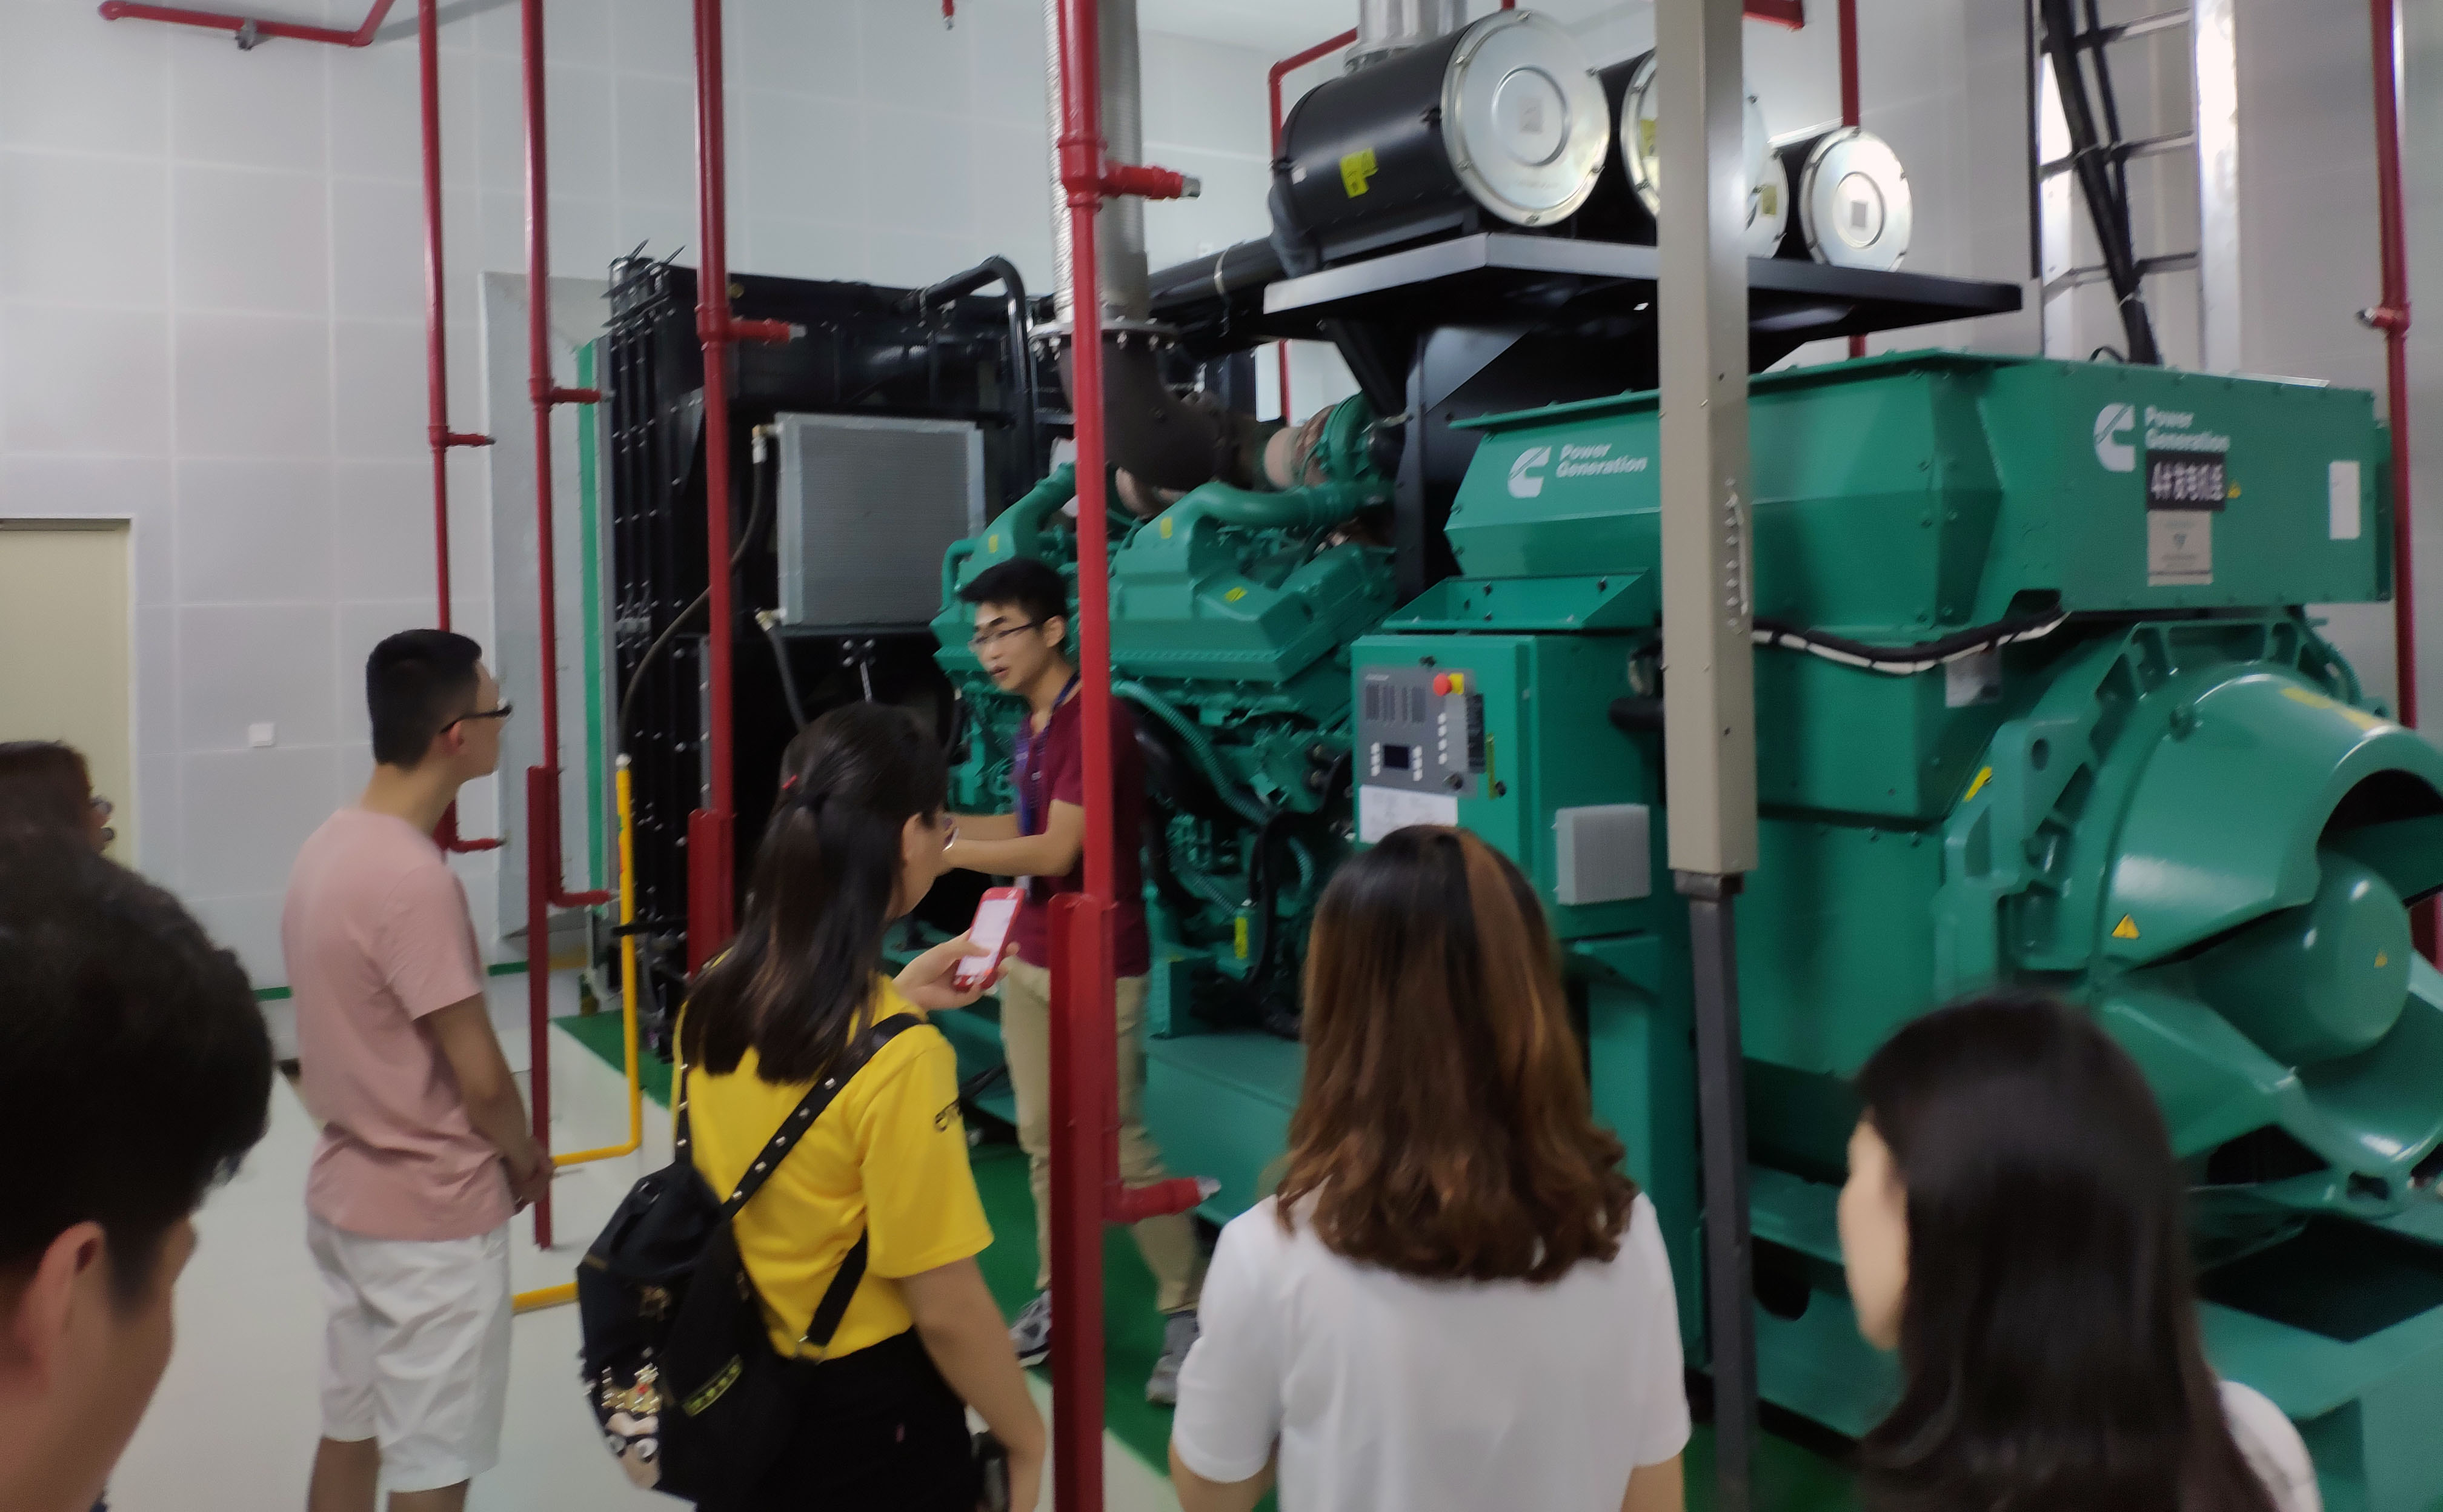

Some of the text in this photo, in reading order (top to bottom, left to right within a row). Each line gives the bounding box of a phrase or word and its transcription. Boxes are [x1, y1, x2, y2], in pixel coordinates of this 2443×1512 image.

[2145, 405, 2195, 428] Power
[1560, 443, 1612, 460] Power
[1556, 455, 1648, 478] Generation
